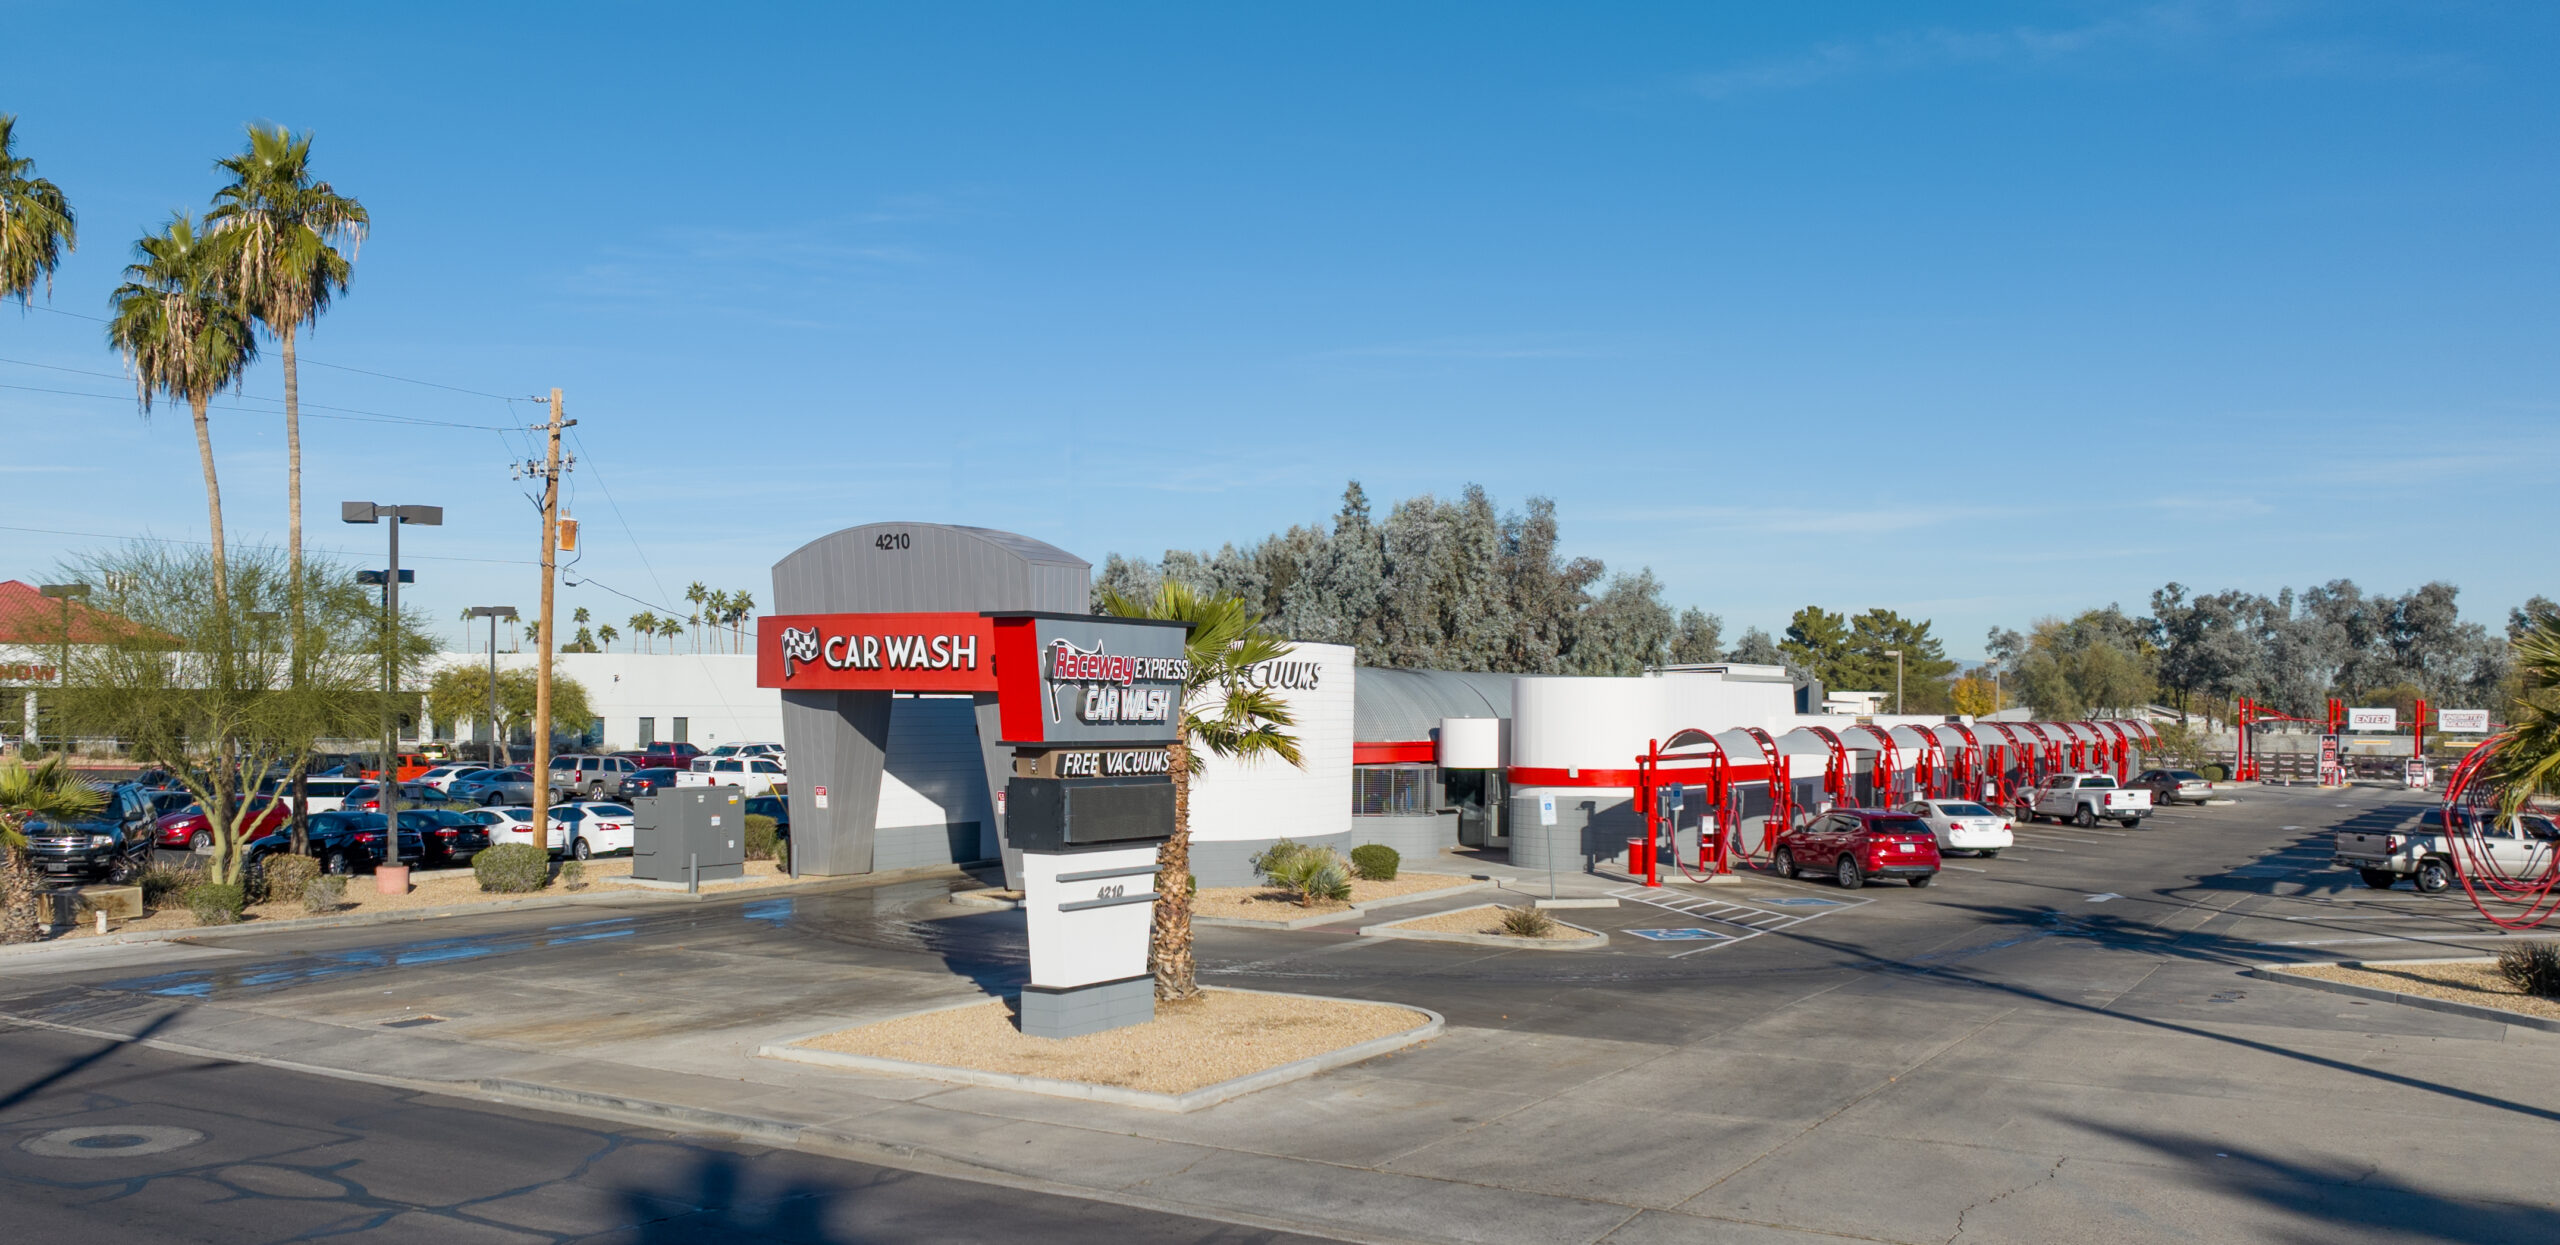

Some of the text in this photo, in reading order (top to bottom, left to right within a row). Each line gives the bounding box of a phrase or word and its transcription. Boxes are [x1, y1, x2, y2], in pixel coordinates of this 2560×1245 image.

[875, 533, 910, 550] 4210
[824, 635, 977, 671] CAR WASH
[0, 664, 56, 680] NOW
[1054, 646, 1189, 687] Raceway EXPRESS
[1084, 689, 1171, 721] CAR WASH
[2354, 714, 2390, 725] ENTER
[1063, 751, 1170, 775] FREE VACUUMS
[1097, 884, 1124, 899] 4210
